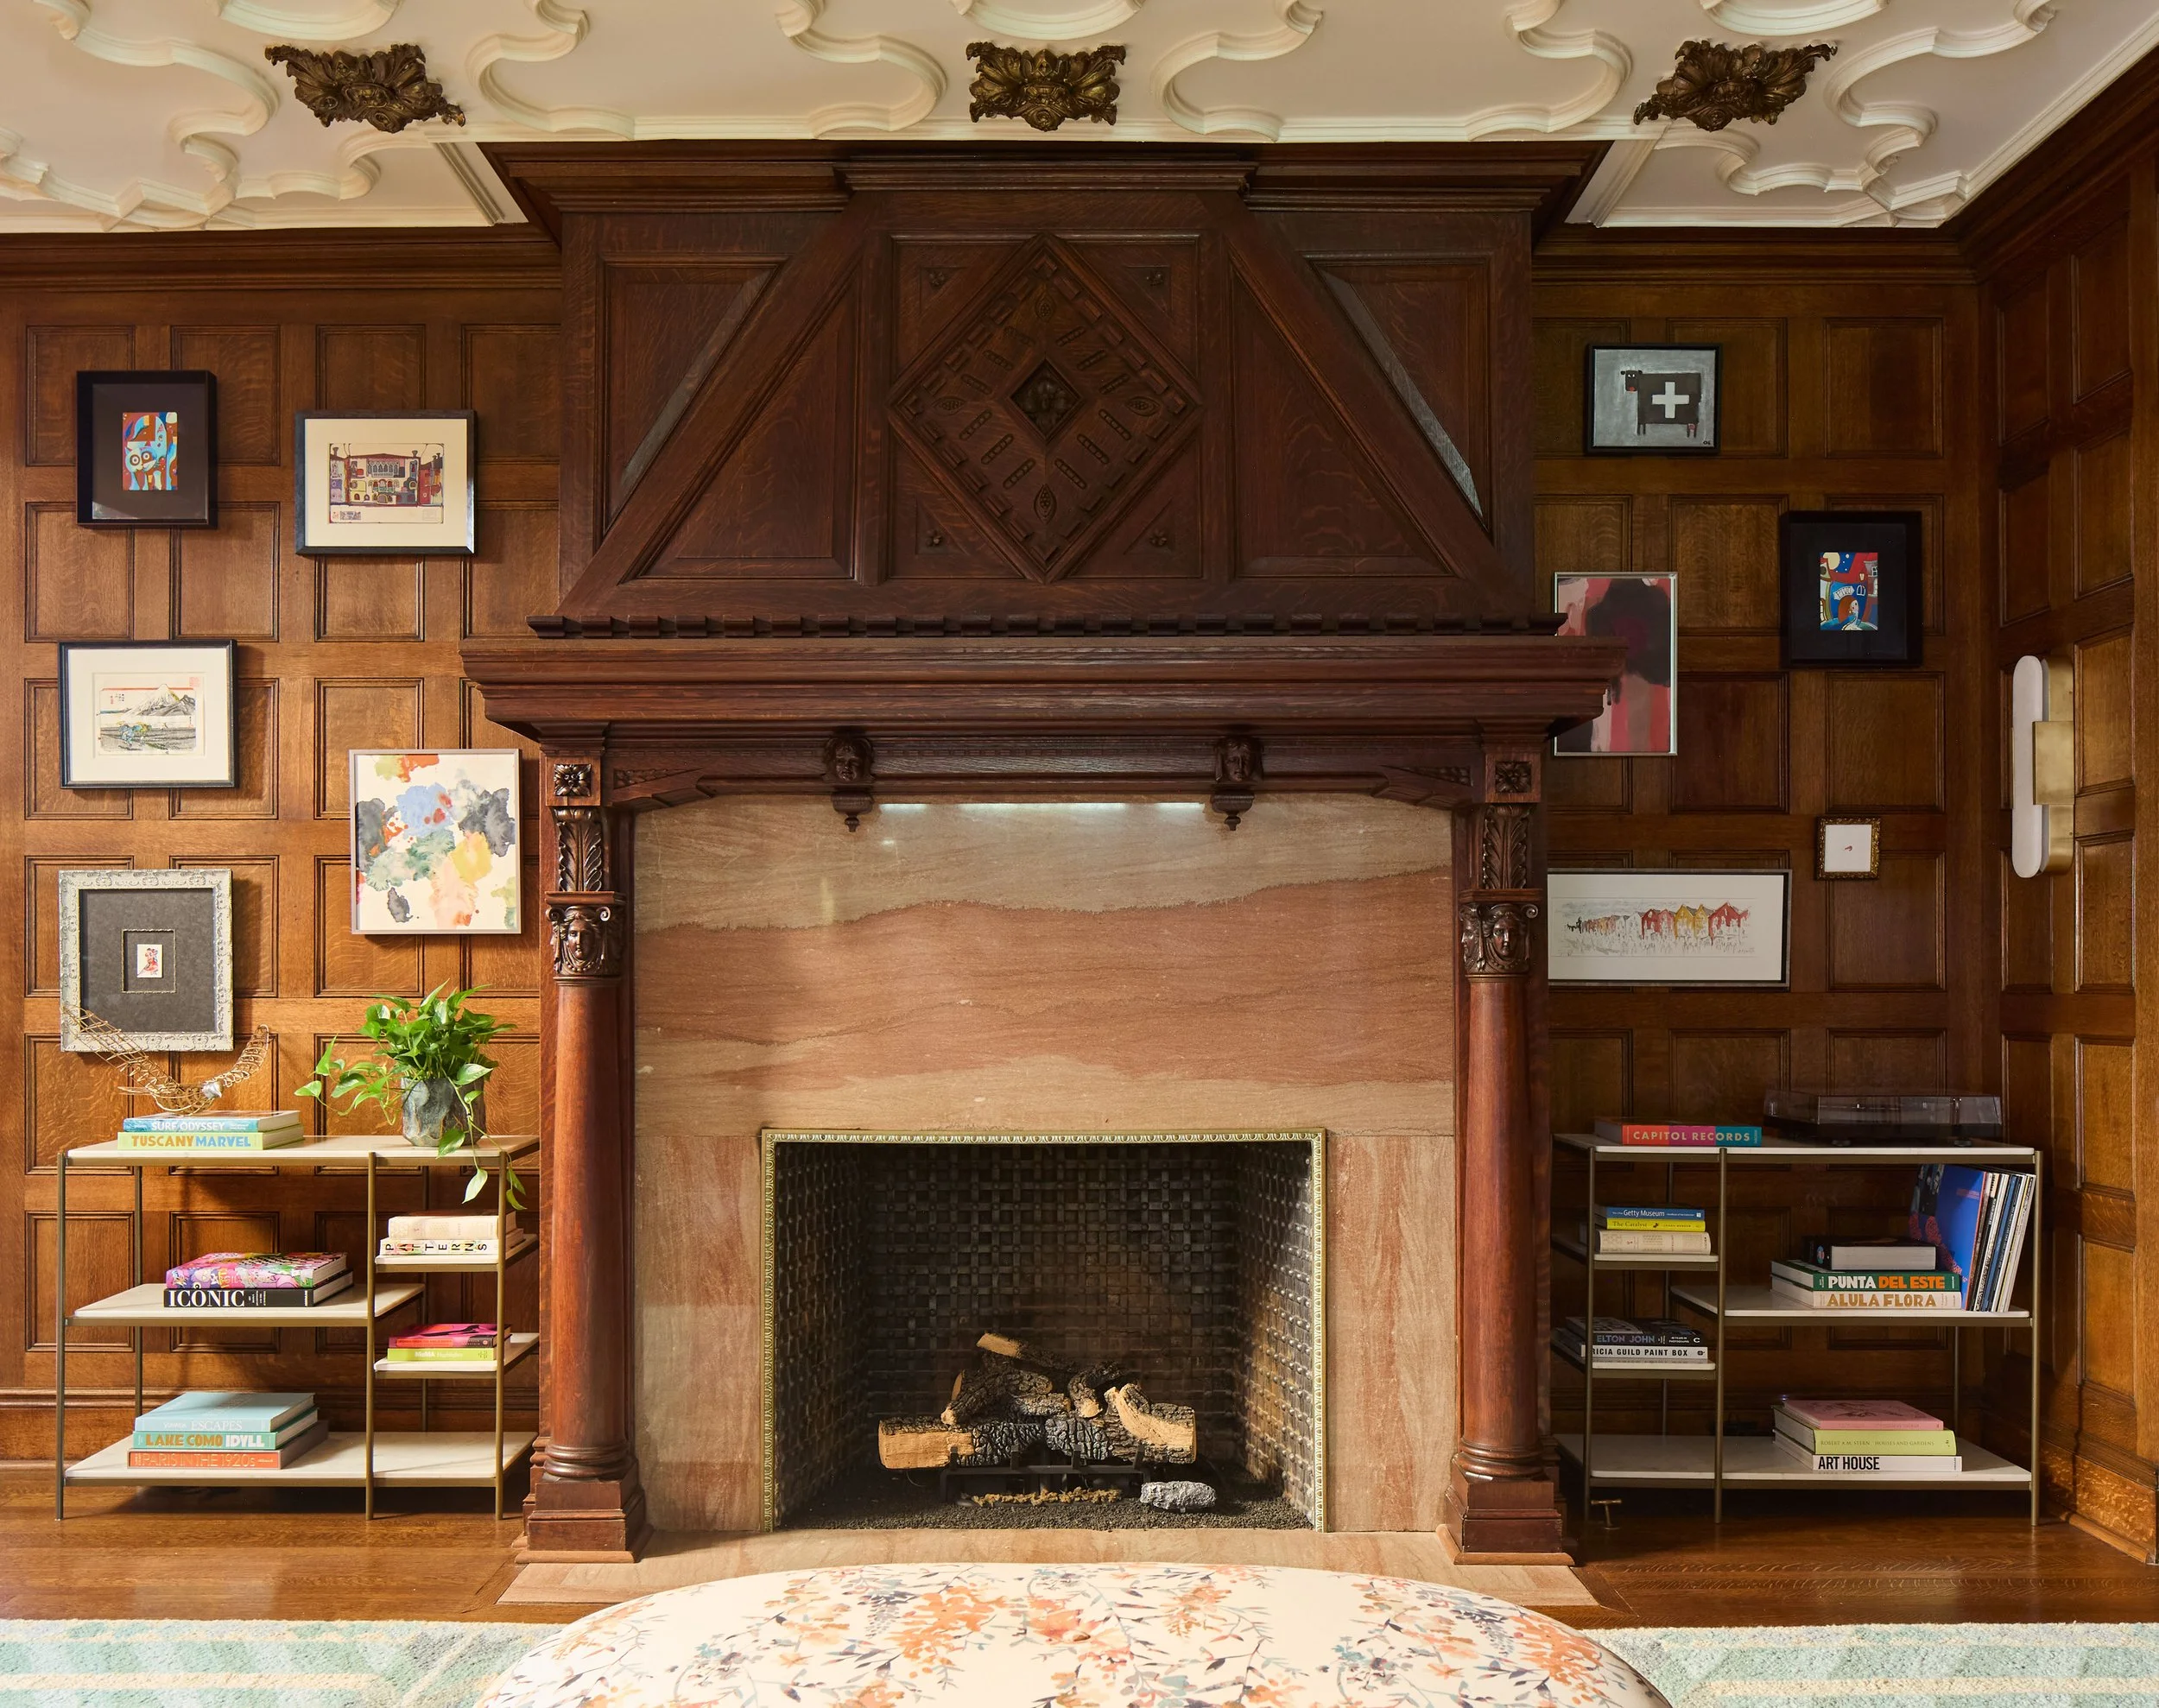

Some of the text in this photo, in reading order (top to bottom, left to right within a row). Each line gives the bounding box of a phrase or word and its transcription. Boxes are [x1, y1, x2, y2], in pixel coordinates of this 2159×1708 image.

[152, 1122, 177, 1131] SURF
[179, 1122, 225, 1131] ODYSSEY
[131, 1136, 251, 1147] TUSCANY MARVEL
[1633, 1131, 1687, 1141] CAPITOL
[1692, 1132, 1751, 1142] RECORDS
[1624, 1209, 1639, 1218] Getty
[1828, 1275, 1877, 1289] PUNTA
[1878, 1275, 1907, 1289] DEL
[1909, 1275, 1945, 1289] ESTE
[168, 1290, 245, 1307] ICONIC
[1827, 1294, 1880, 1306] ALULA
[1883, 1294, 1936, 1307] FLORA
[1629, 1335, 1656, 1344] JOHN
[191, 1420, 243, 1431] ESCAPES
[145, 1433, 184, 1446] LAKE
[187, 1433, 223, 1447] COMO
[225, 1434, 265, 1447] IDYLL
[142, 1453, 177, 1467] PARIS
[179, 1453, 192, 1467] IN
[193, 1453, 218, 1467] THE
[221, 1453, 256, 1467] 1920s
[1818, 1456, 1880, 1471] ART HOUSE
